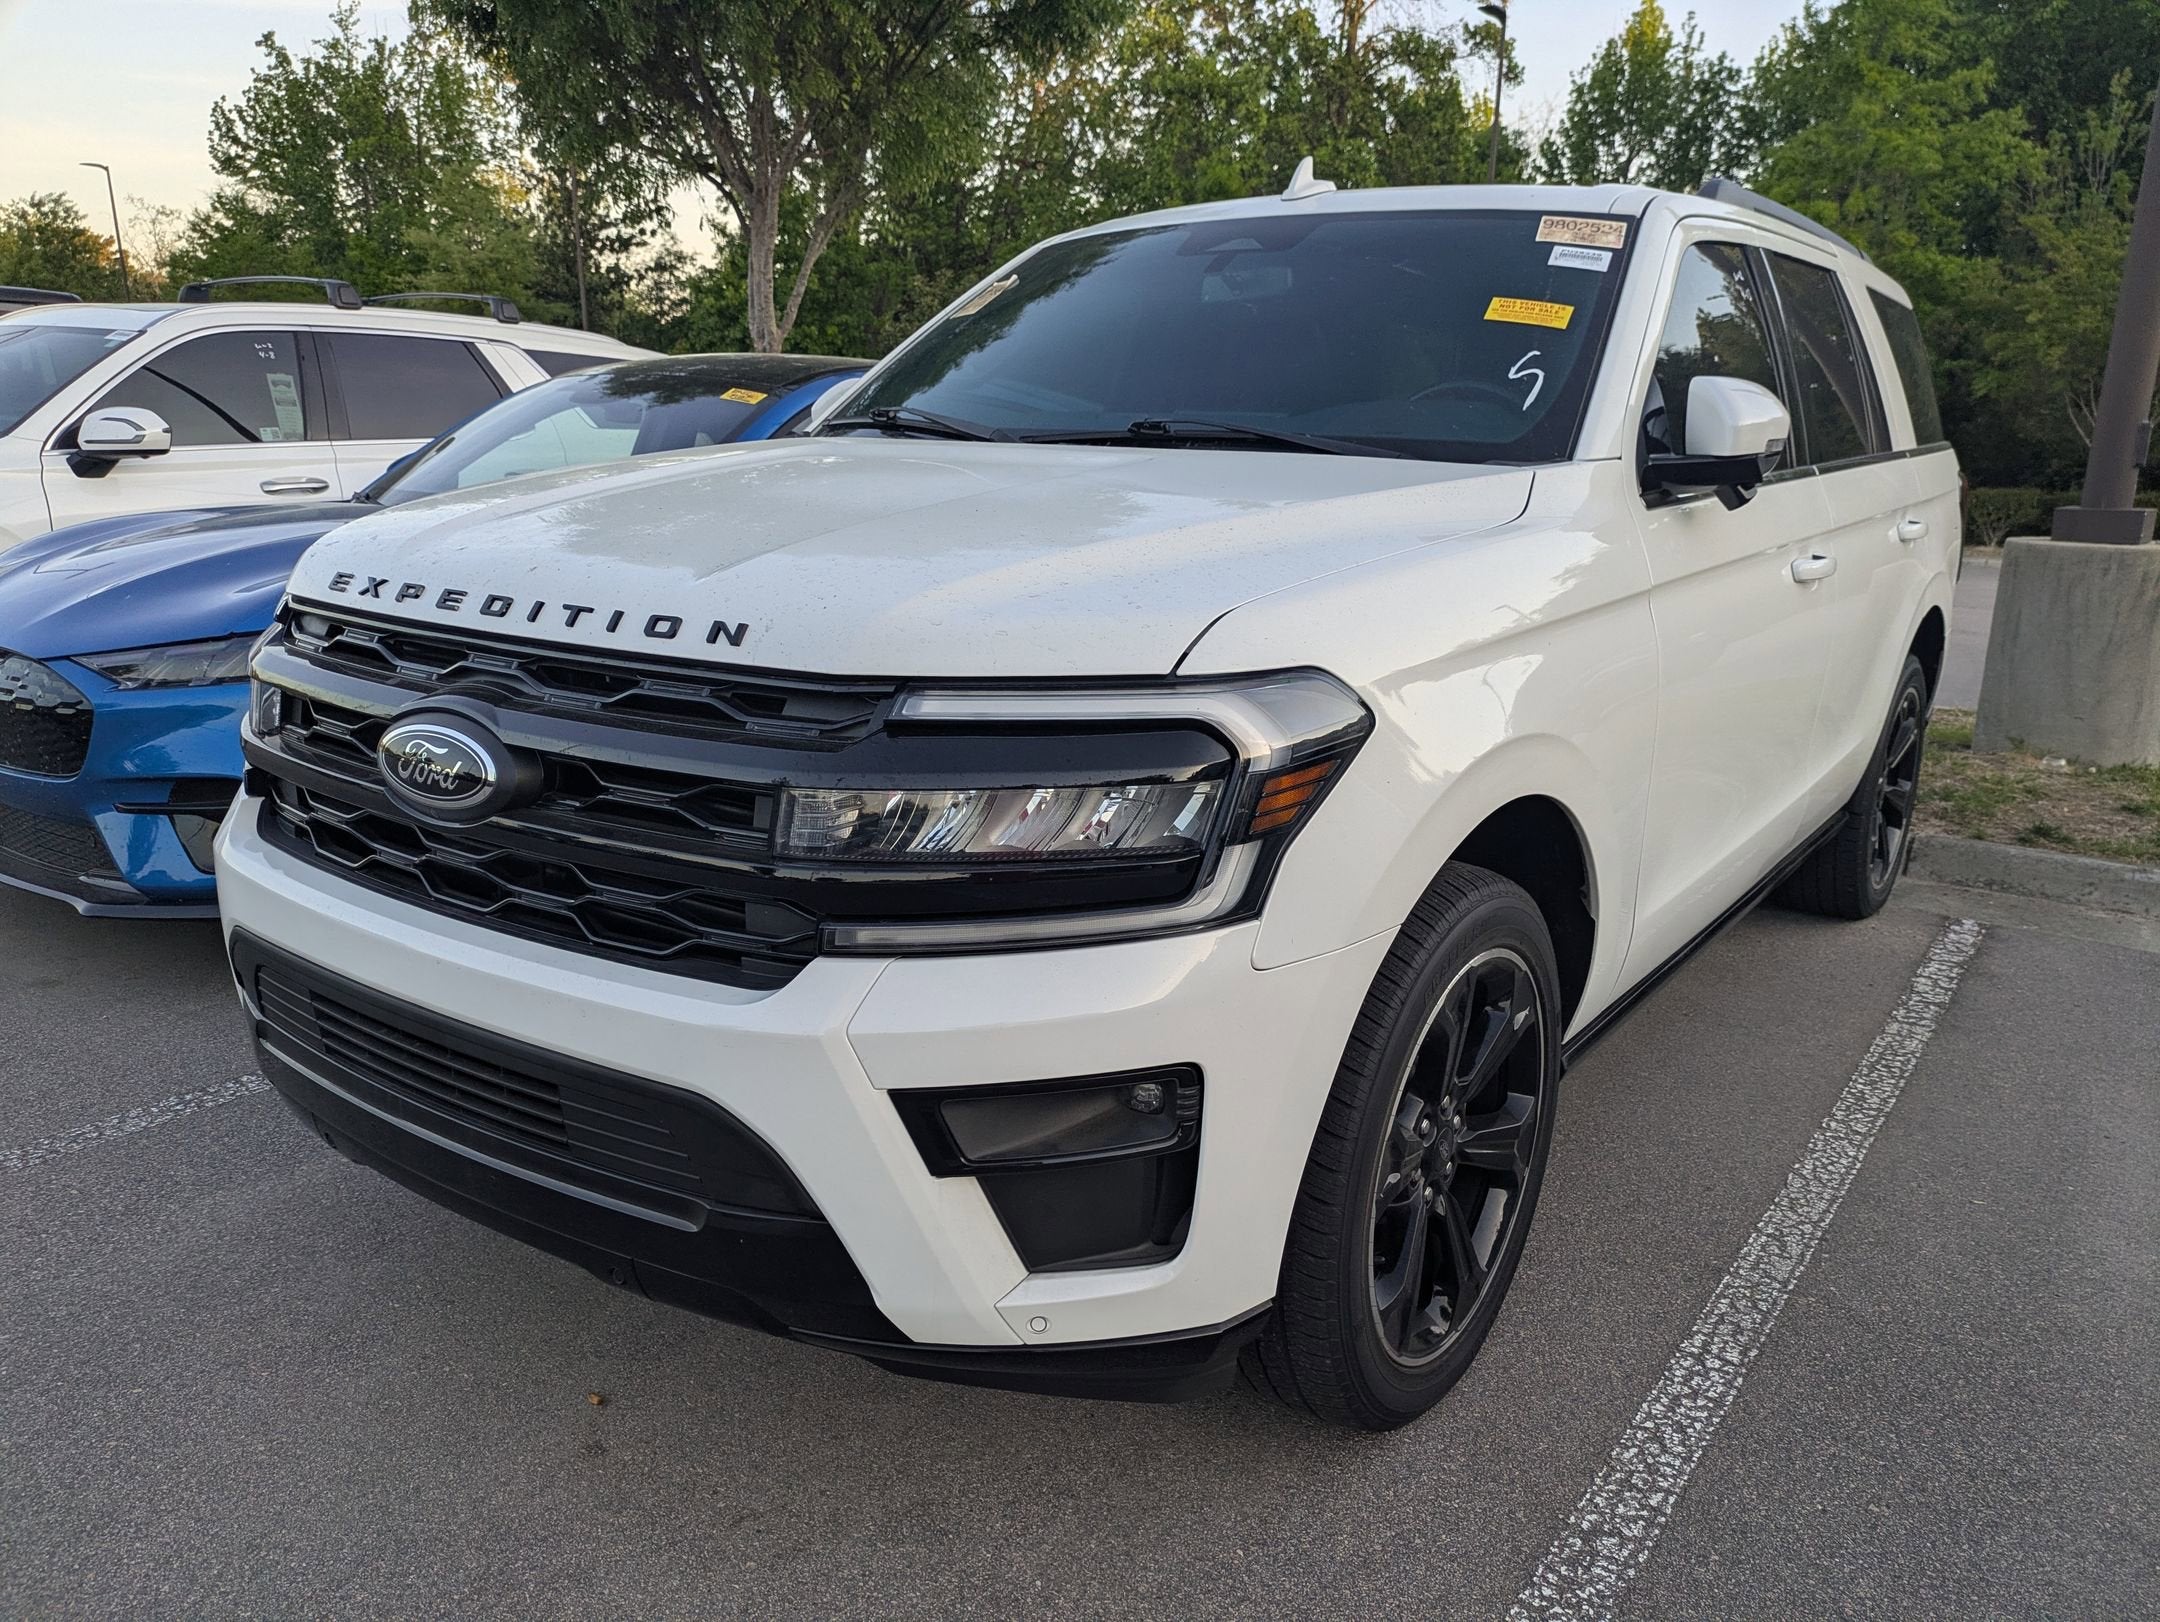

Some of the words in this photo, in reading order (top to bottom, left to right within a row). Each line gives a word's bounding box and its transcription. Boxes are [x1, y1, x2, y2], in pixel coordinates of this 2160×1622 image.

[1543, 218, 1624, 235] 9802524
[1520, 300, 1555, 308] VEHICLE
[328, 571, 749, 647] EXPEDITION
[397, 739, 464, 793] Ford
